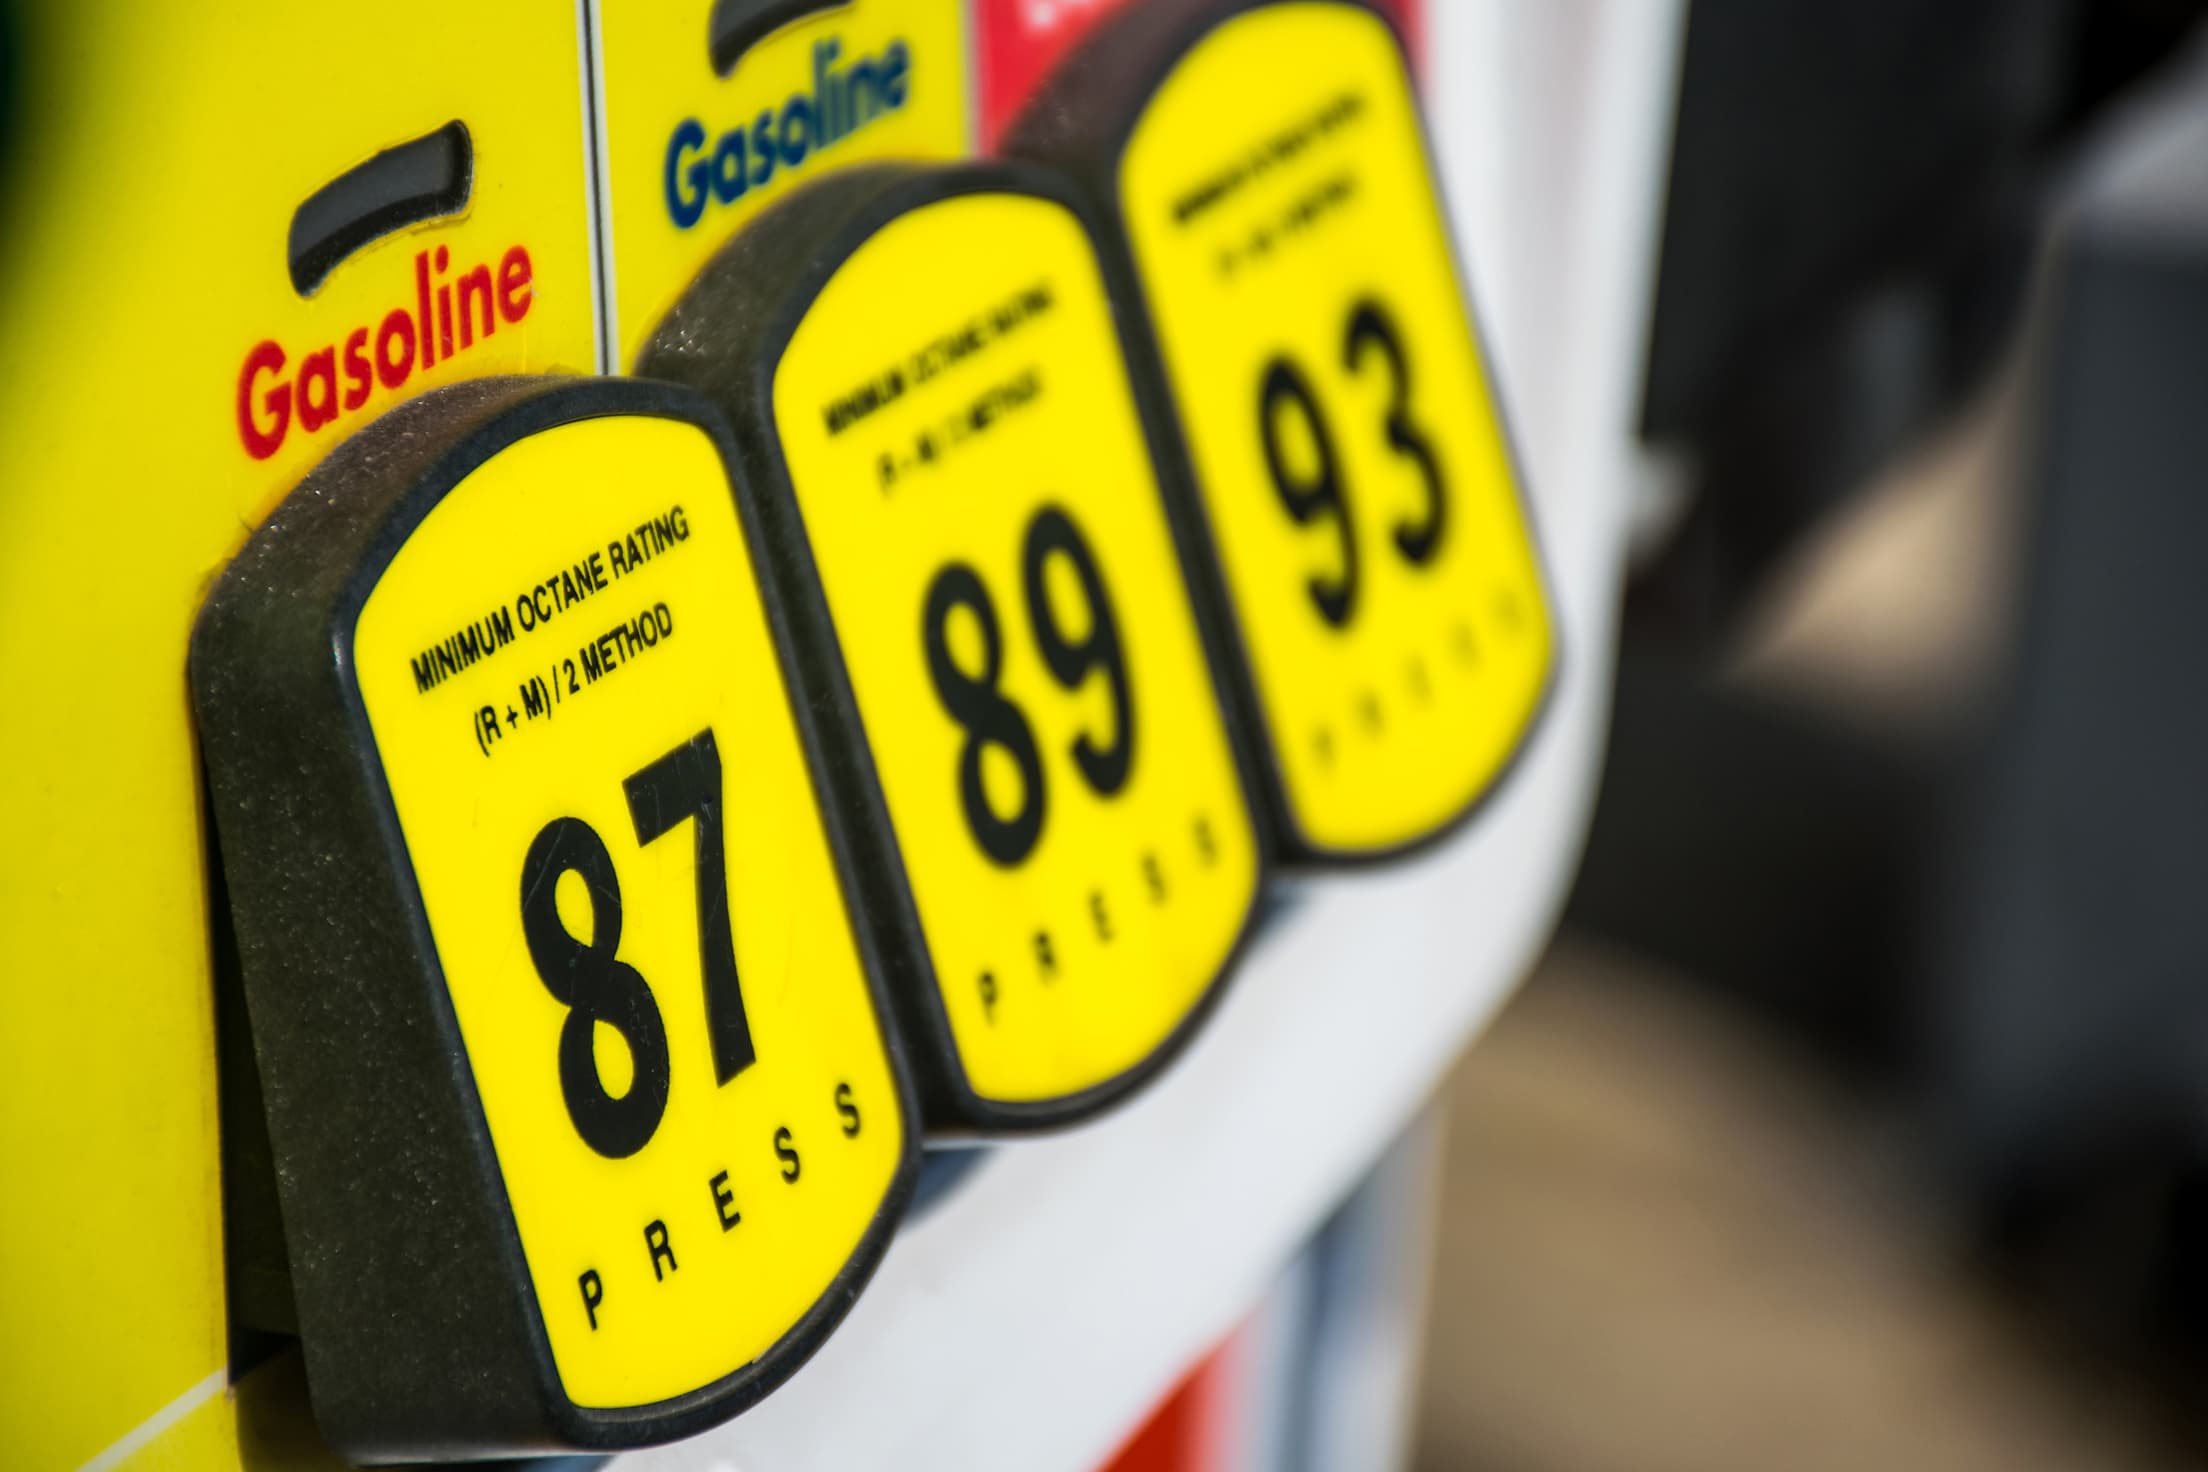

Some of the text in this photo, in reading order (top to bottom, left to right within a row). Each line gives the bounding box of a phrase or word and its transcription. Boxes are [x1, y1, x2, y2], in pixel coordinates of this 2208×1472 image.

[665, 36, 910, 230] Gasoline
[237, 244, 533, 461] Gasoline
[1258, 293, 1449, 631] 93
[410, 504, 690, 694] MINIMUM OCTANE RATING
[580, 602, 673, 684] METHOD
[921, 503, 1136, 871] 89
[520, 726, 756, 1160] 87
